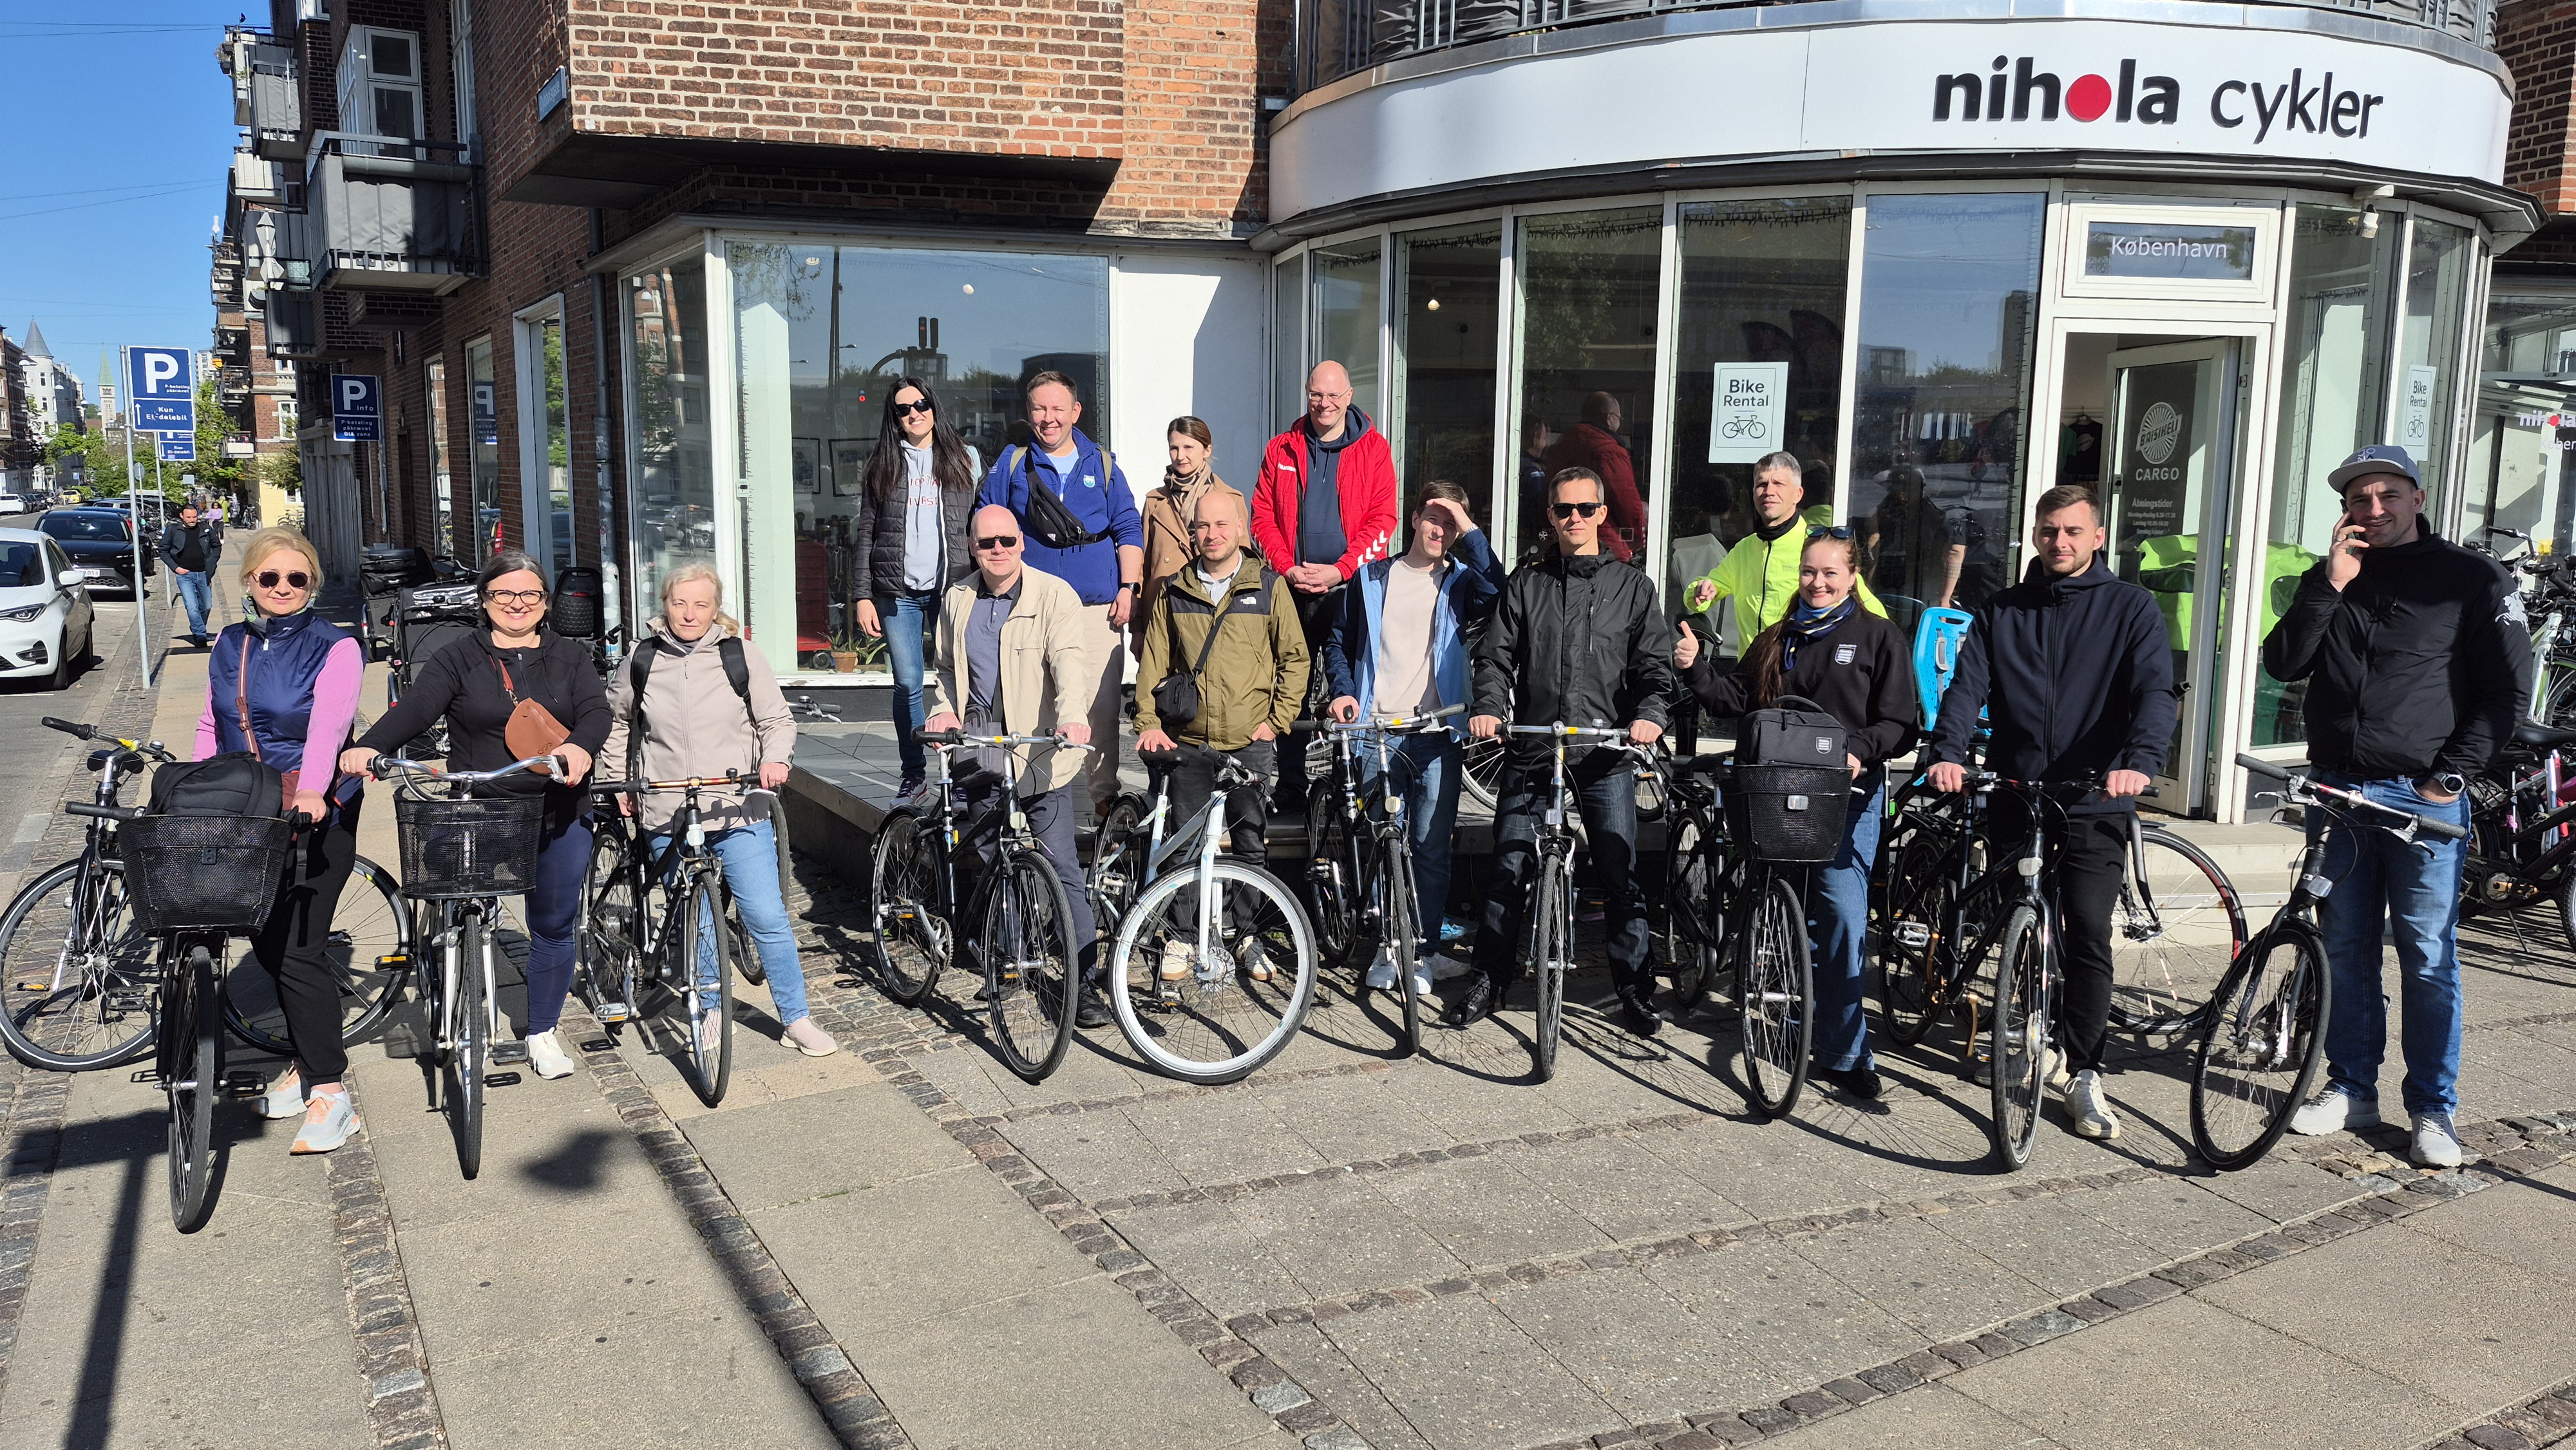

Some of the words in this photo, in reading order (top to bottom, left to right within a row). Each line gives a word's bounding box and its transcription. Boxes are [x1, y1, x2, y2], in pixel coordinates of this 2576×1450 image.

[2210, 68, 2383, 144] cykler
[2111, 236, 2228, 259] København
[144, 353, 179, 393] P
[1729, 379, 1765, 393] Bike
[2413, 381, 2427, 394] Bike
[343, 380, 366, 410] P
[1723, 395, 1768, 406] Rental
[2410, 395, 2427, 408] Rental
[2136, 467, 2179, 481] CARGO
